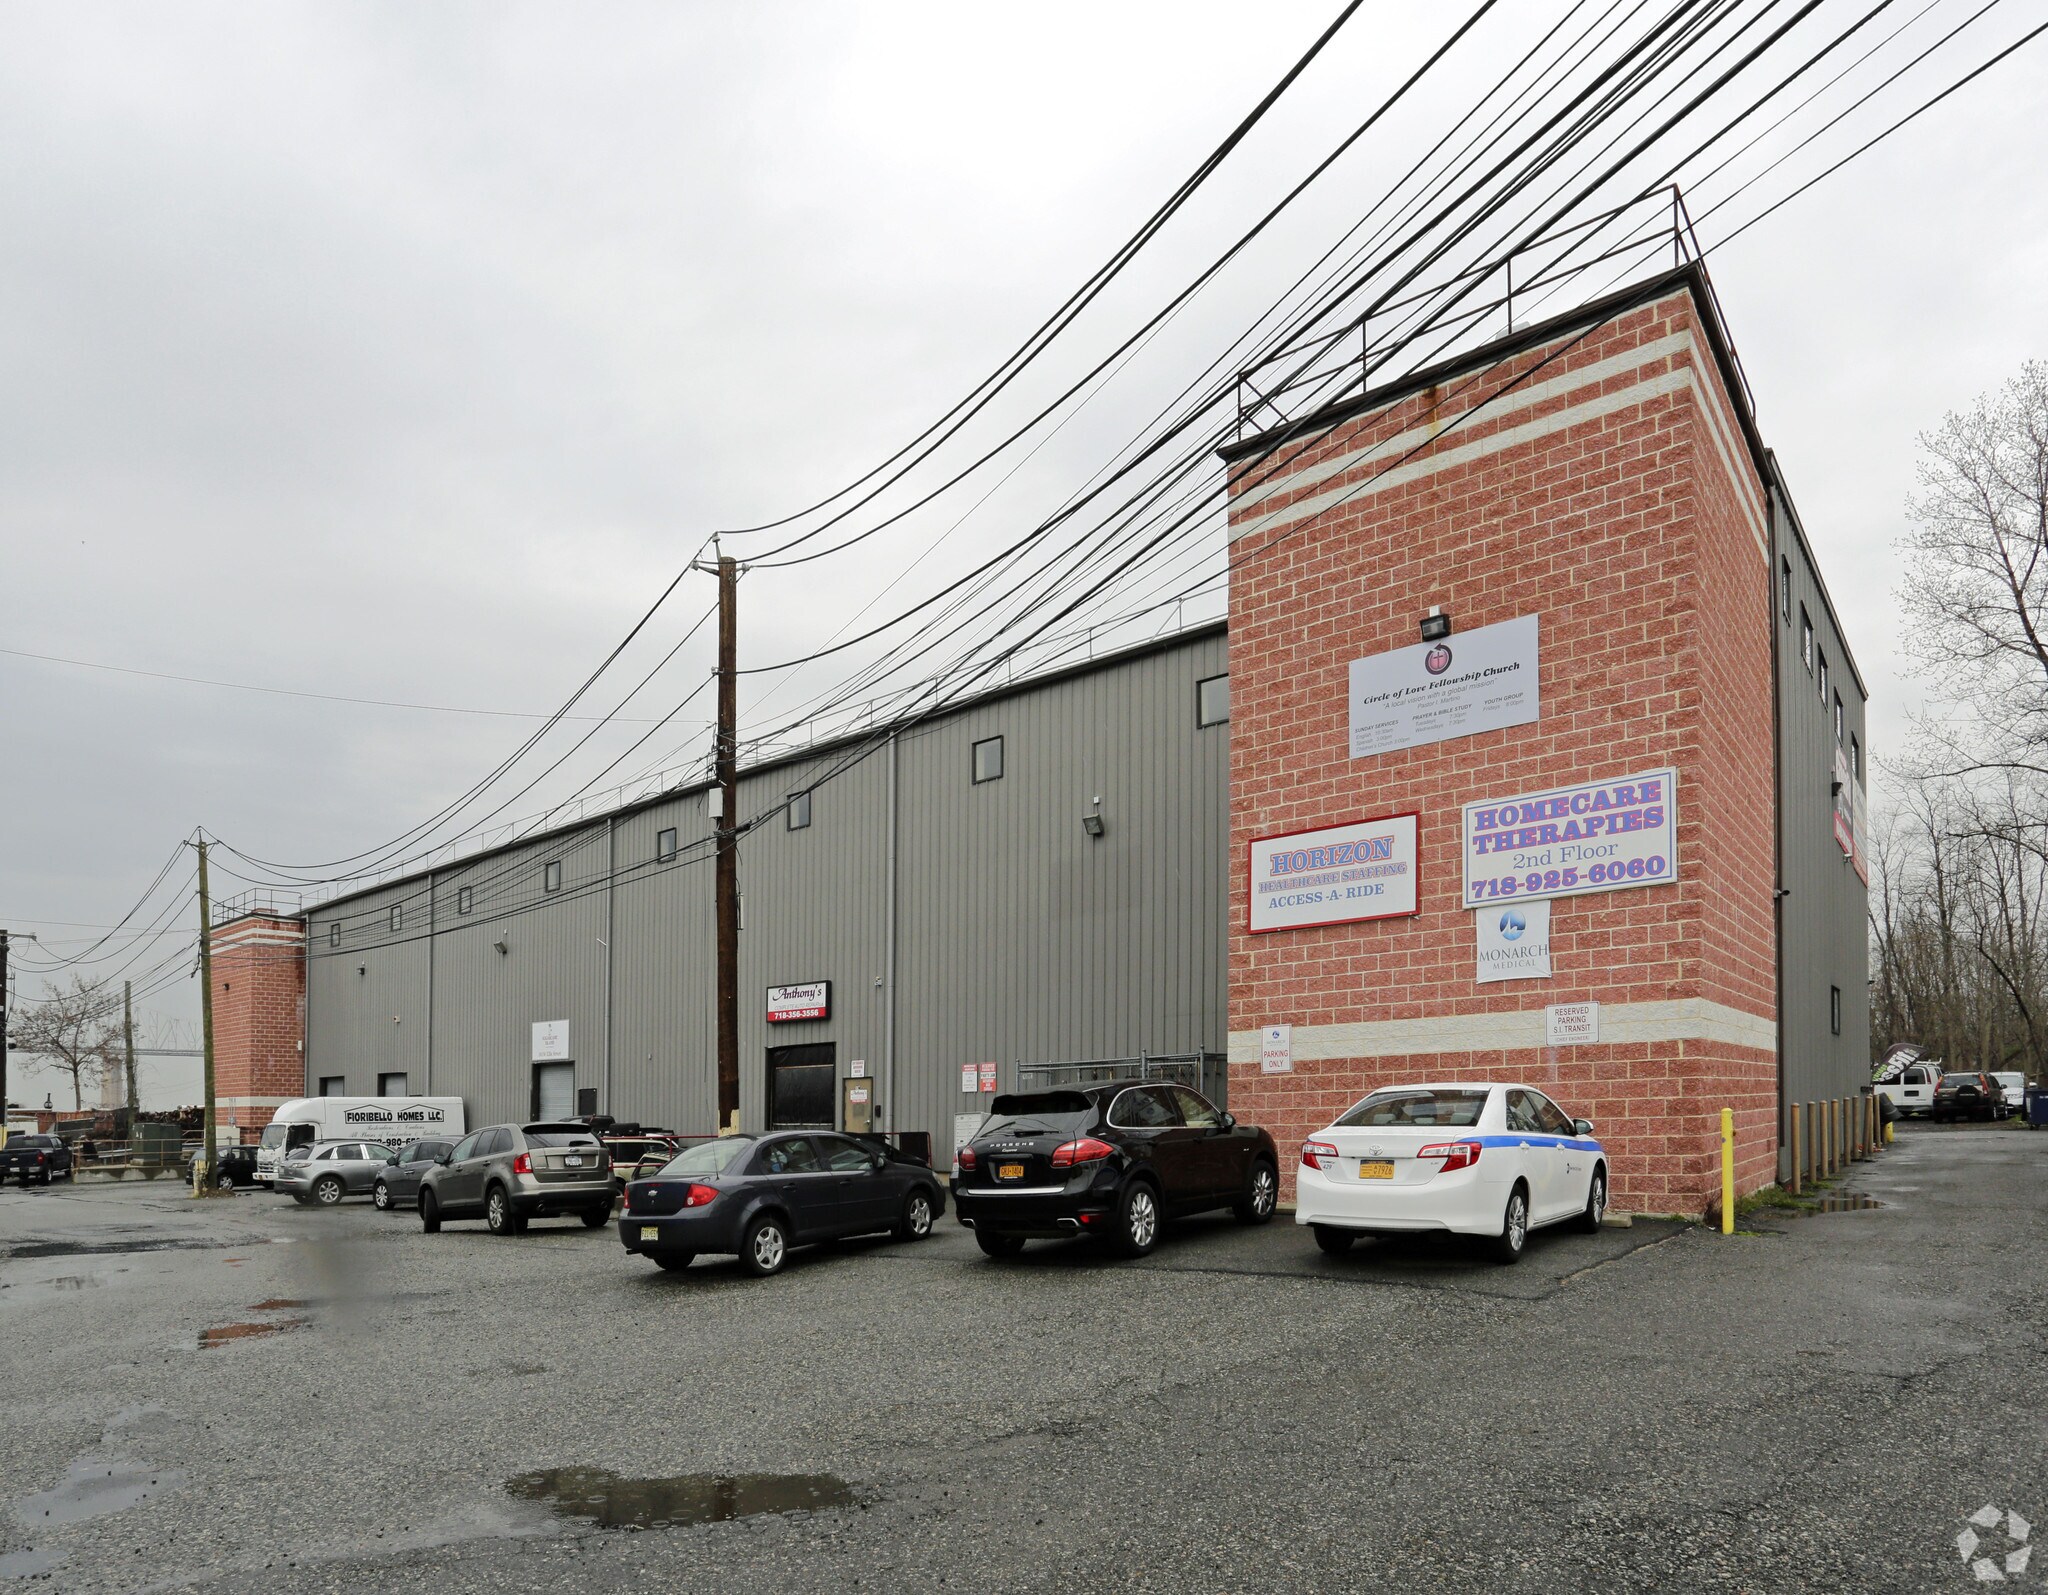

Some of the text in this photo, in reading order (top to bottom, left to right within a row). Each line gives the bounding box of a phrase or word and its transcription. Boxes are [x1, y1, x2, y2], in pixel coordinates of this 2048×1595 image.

[1364, 662, 1520, 704] Circle of Love Fellowship Church
[1391, 699, 1406, 708] local
[1407, 695, 1425, 704] vision
[1427, 691, 1440, 700] with
[1447, 684, 1468, 696] global
[1484, 692, 1524, 705] YOUTH GROUP
[1412, 712, 1433, 720] PRAYER
[1455, 704, 1472, 712] STUDY
[1355, 720, 1399, 733] SUNDAY SERVICES
[1474, 780, 1661, 831] HOMECARE
[1472, 805, 1664, 855] THERAPIES
[1270, 835, 1395, 876] HORIZON
[1513, 843, 1618, 869] 2nd Floor
[1258, 862, 1407, 894] HEALTHCARE STAFFING
[1471, 855, 1666, 898] 718-925-6060
[1269, 892, 1323, 908] ACCESS
[1346, 884, 1384, 898] RIDE
[1480, 944, 1548, 962] MONARCH
[1493, 959, 1536, 970] MEDICAL
[773, 985, 822, 1001] Anthony's
[775, 1009, 818, 1019] 718-356-3556
[1555, 1007, 1589, 1016] RESERVED
[1558, 1015, 1586, 1024] PARKING
[1565, 1024, 1590, 1033] TRANSIT
[1264, 1050, 1288, 1058] PARKING
[347, 1112, 442, 1122] FIORIBELLO HOMES LLC.
